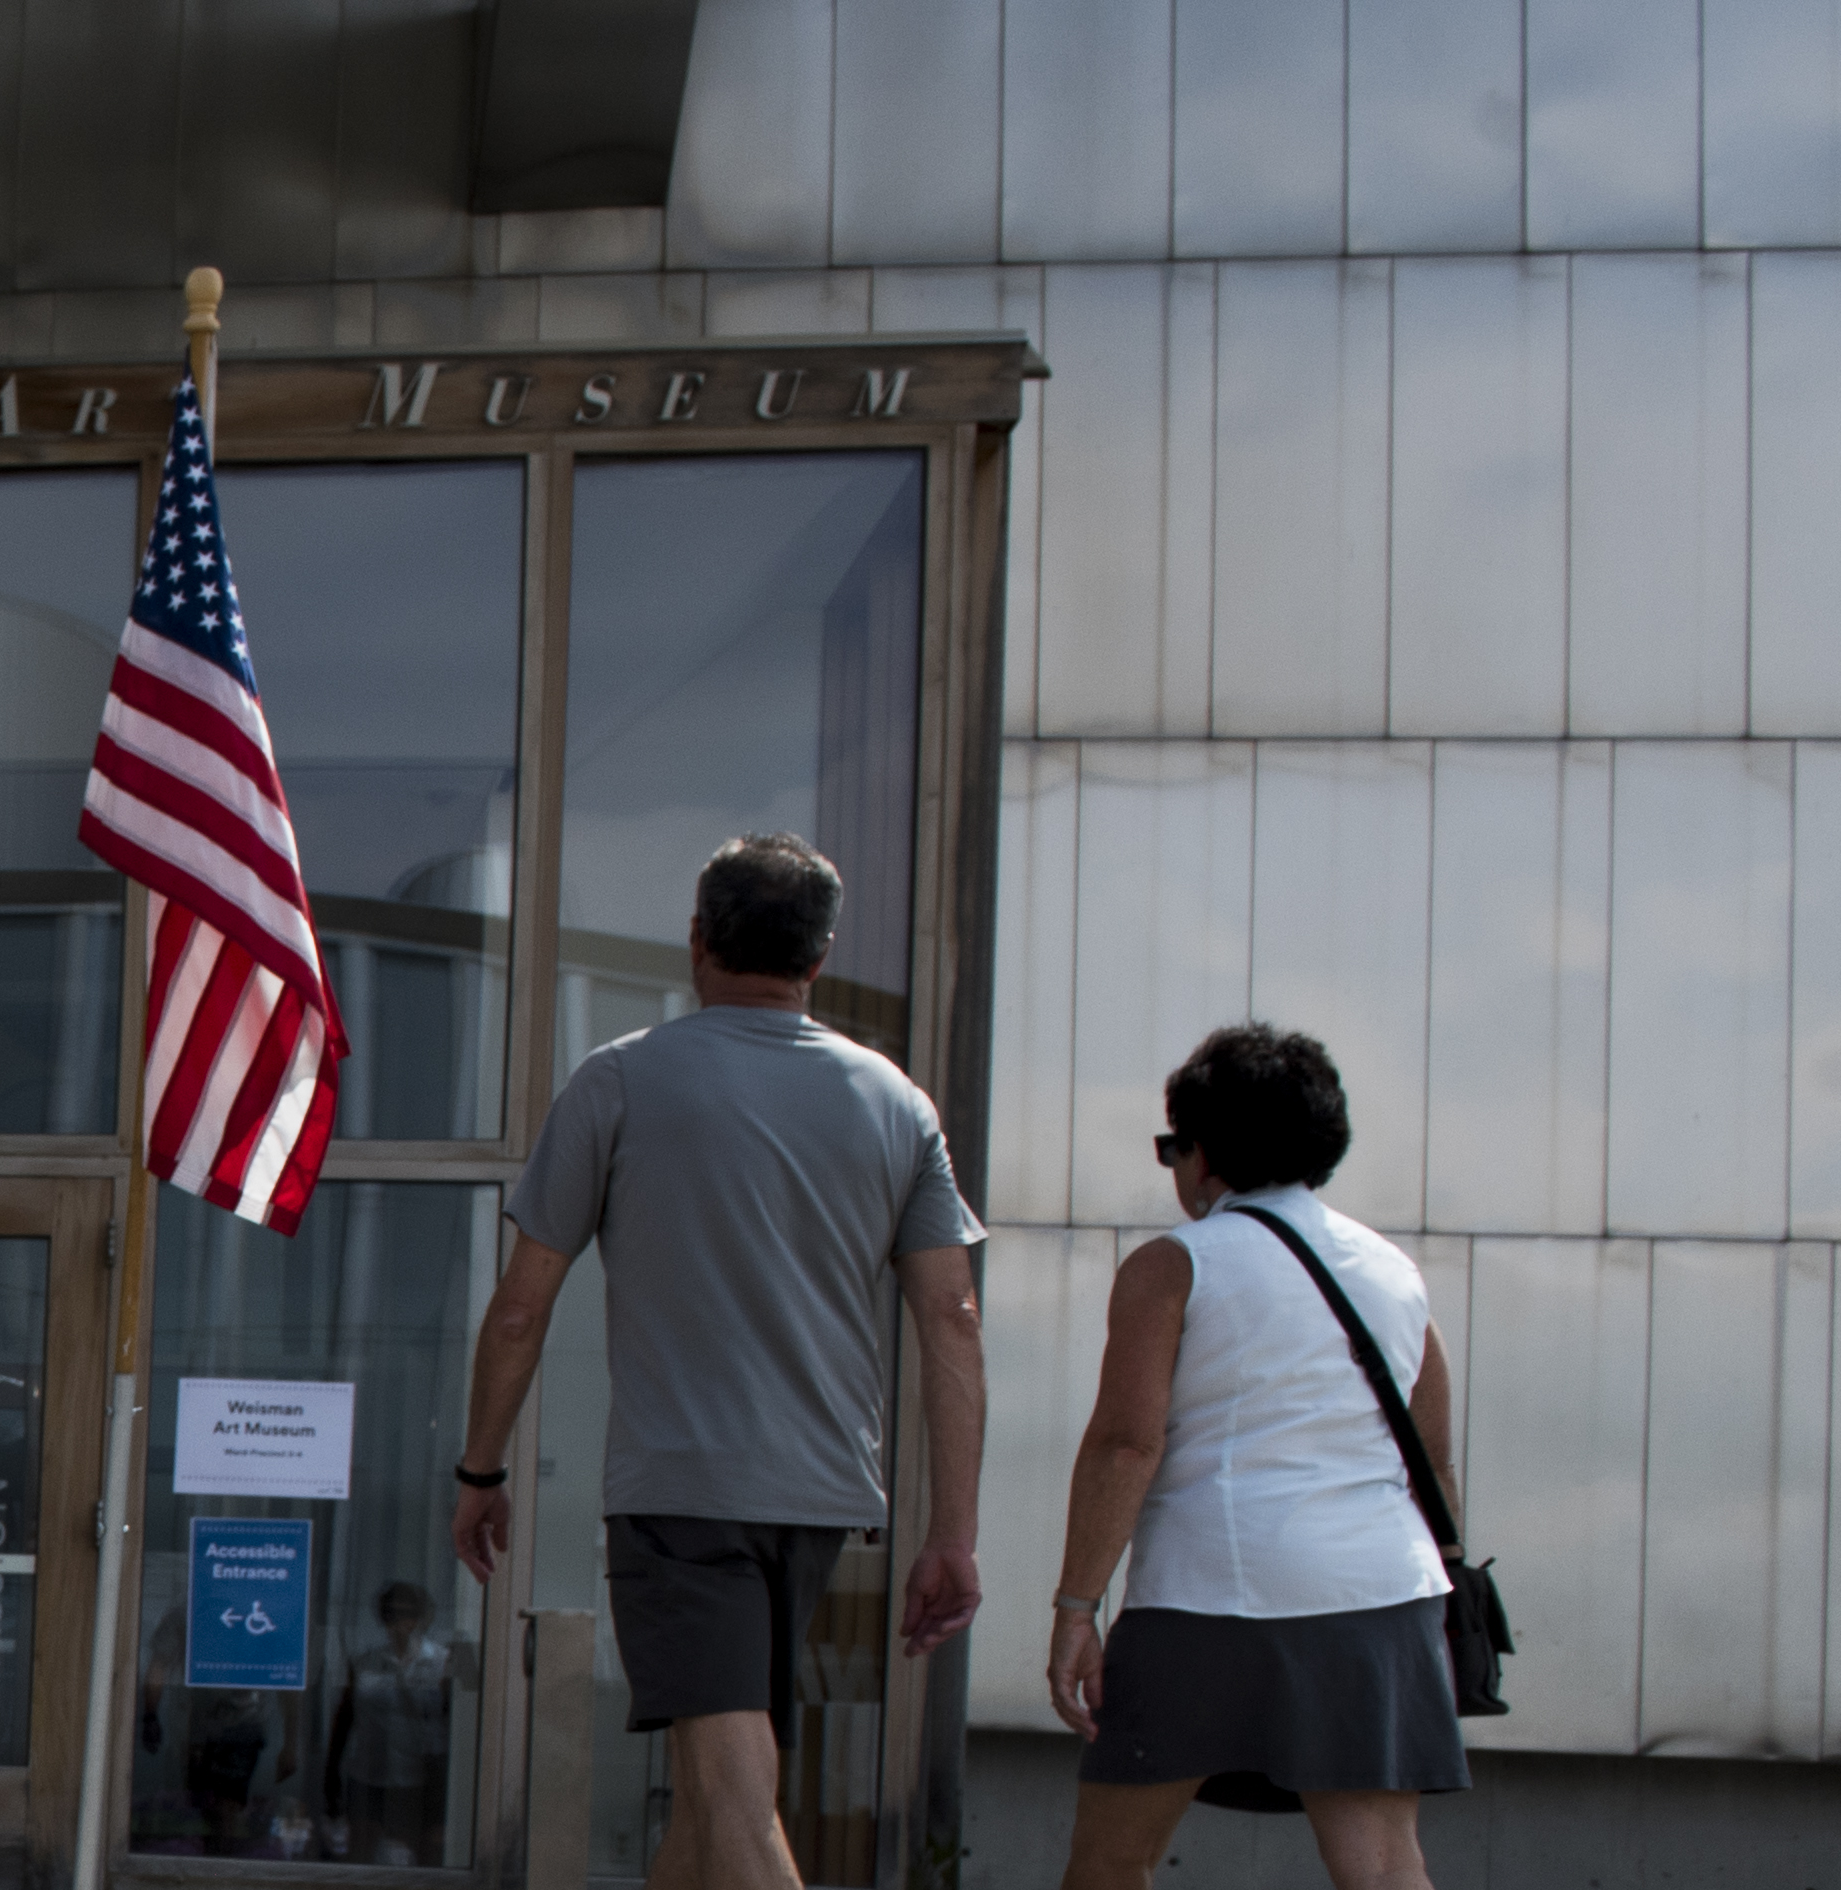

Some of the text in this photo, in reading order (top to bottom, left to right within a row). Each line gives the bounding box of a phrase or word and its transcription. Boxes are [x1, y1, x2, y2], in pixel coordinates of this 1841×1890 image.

[356, 361, 916, 430] MUSEUM
[227, 1400, 304, 1416] Weisman
[213, 1421, 316, 1437] Art Museum
[206, 1542, 296, 1560] Accessible
[212, 1563, 288, 1581] Entrance
